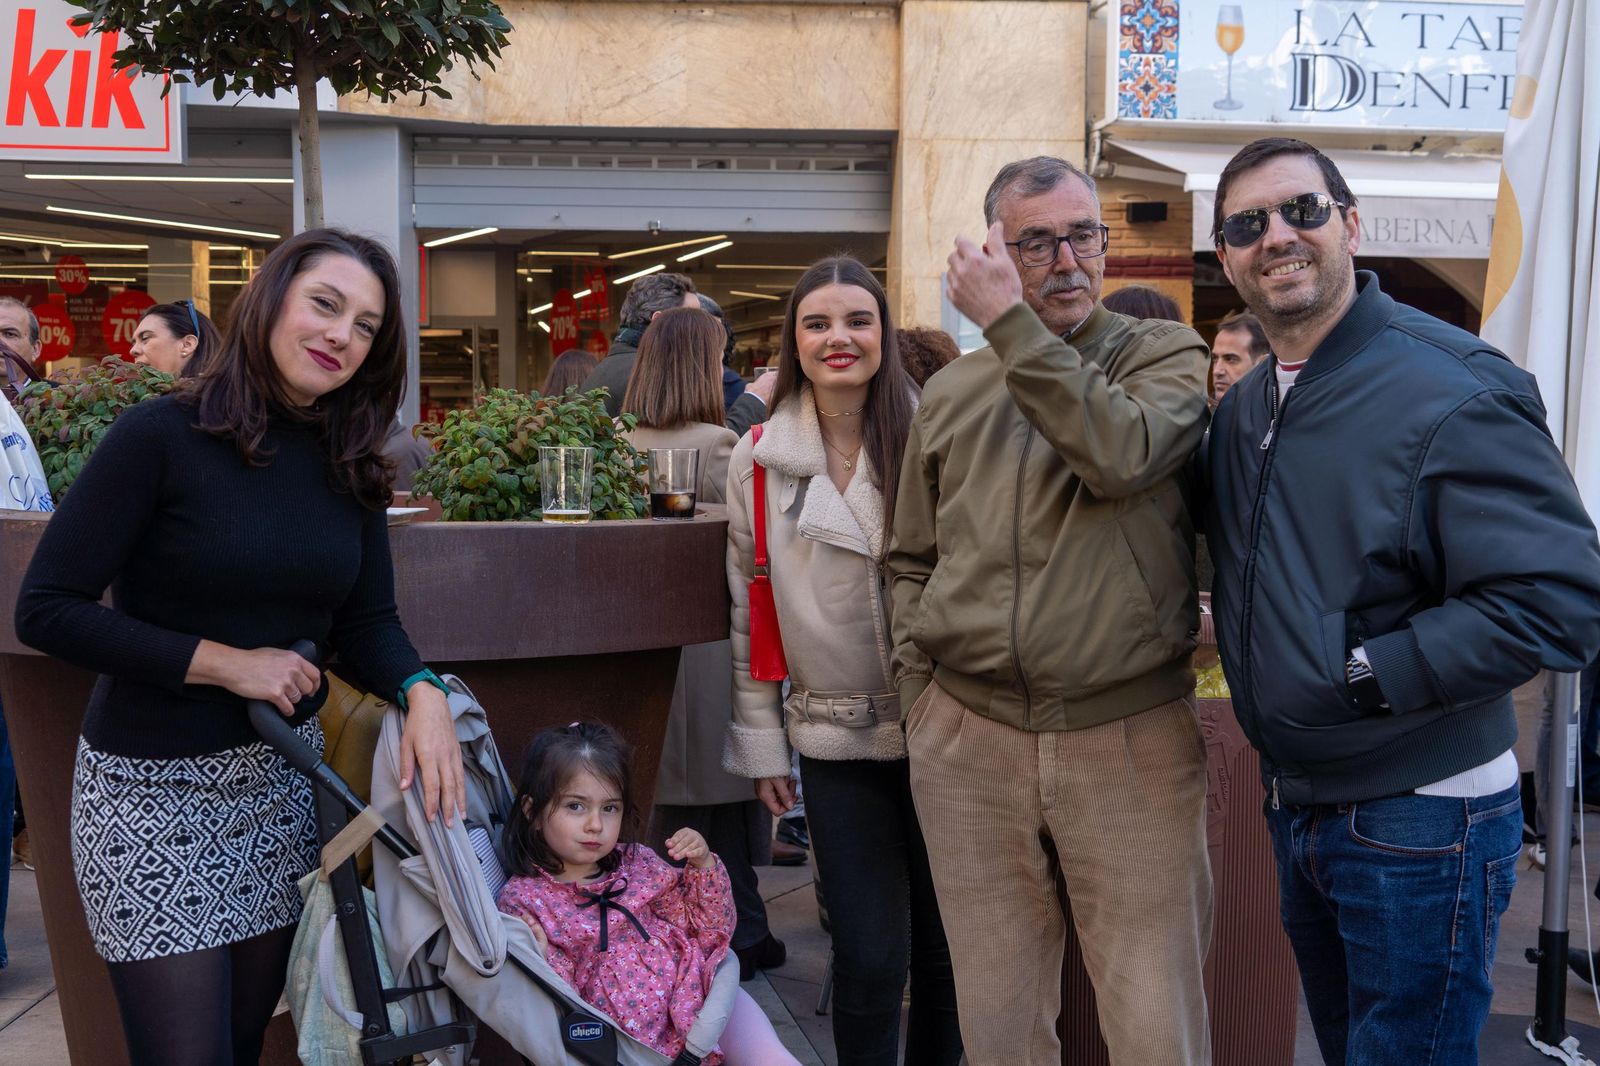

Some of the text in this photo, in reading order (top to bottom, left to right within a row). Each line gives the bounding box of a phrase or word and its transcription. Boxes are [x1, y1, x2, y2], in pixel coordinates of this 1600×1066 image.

[1294, 9, 1376, 48] LA
[5, 8, 146, 129] kik
[58, 268, 86, 283] 30%
[551, 315, 577, 340] 70%
[572, 1025, 600, 1037] chicco
